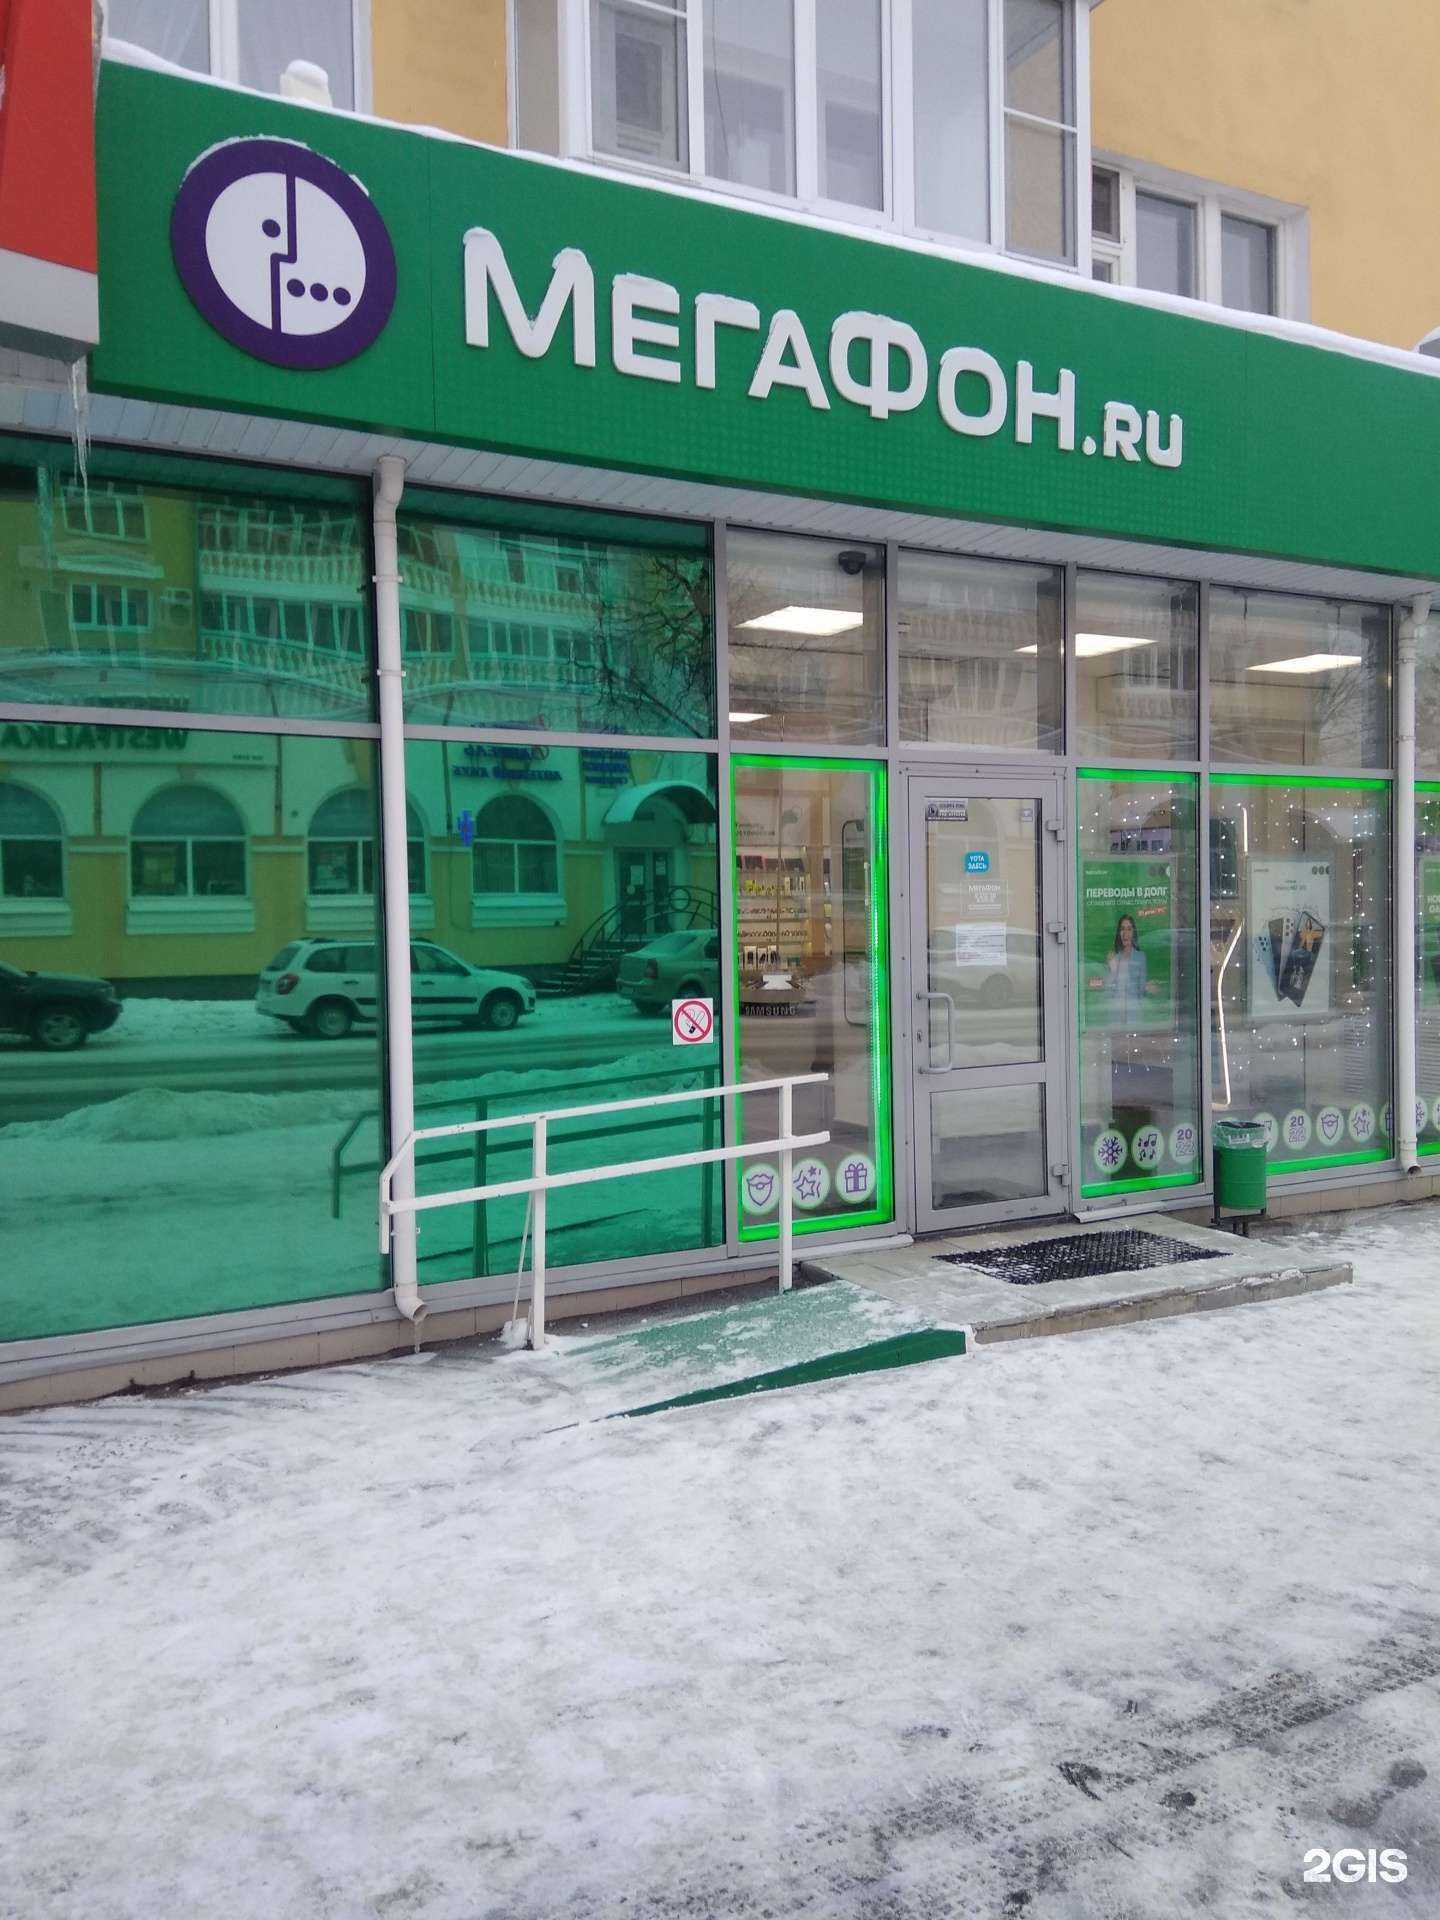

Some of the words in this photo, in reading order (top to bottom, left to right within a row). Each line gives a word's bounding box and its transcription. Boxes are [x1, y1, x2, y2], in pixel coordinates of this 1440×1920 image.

[463, 226, 1184, 468] МЕГАФОН.RU
[967, 862, 987, 870] ЗДЕСЬ
[1086, 887, 1135, 899] ПЕРЕВОДЫ
[1136, 887, 1143, 897] В
[1144, 886, 1168, 898] ДОЛГ
[1290, 1115, 1304, 1127] 20
[1177, 1128, 1193, 1140] 20
